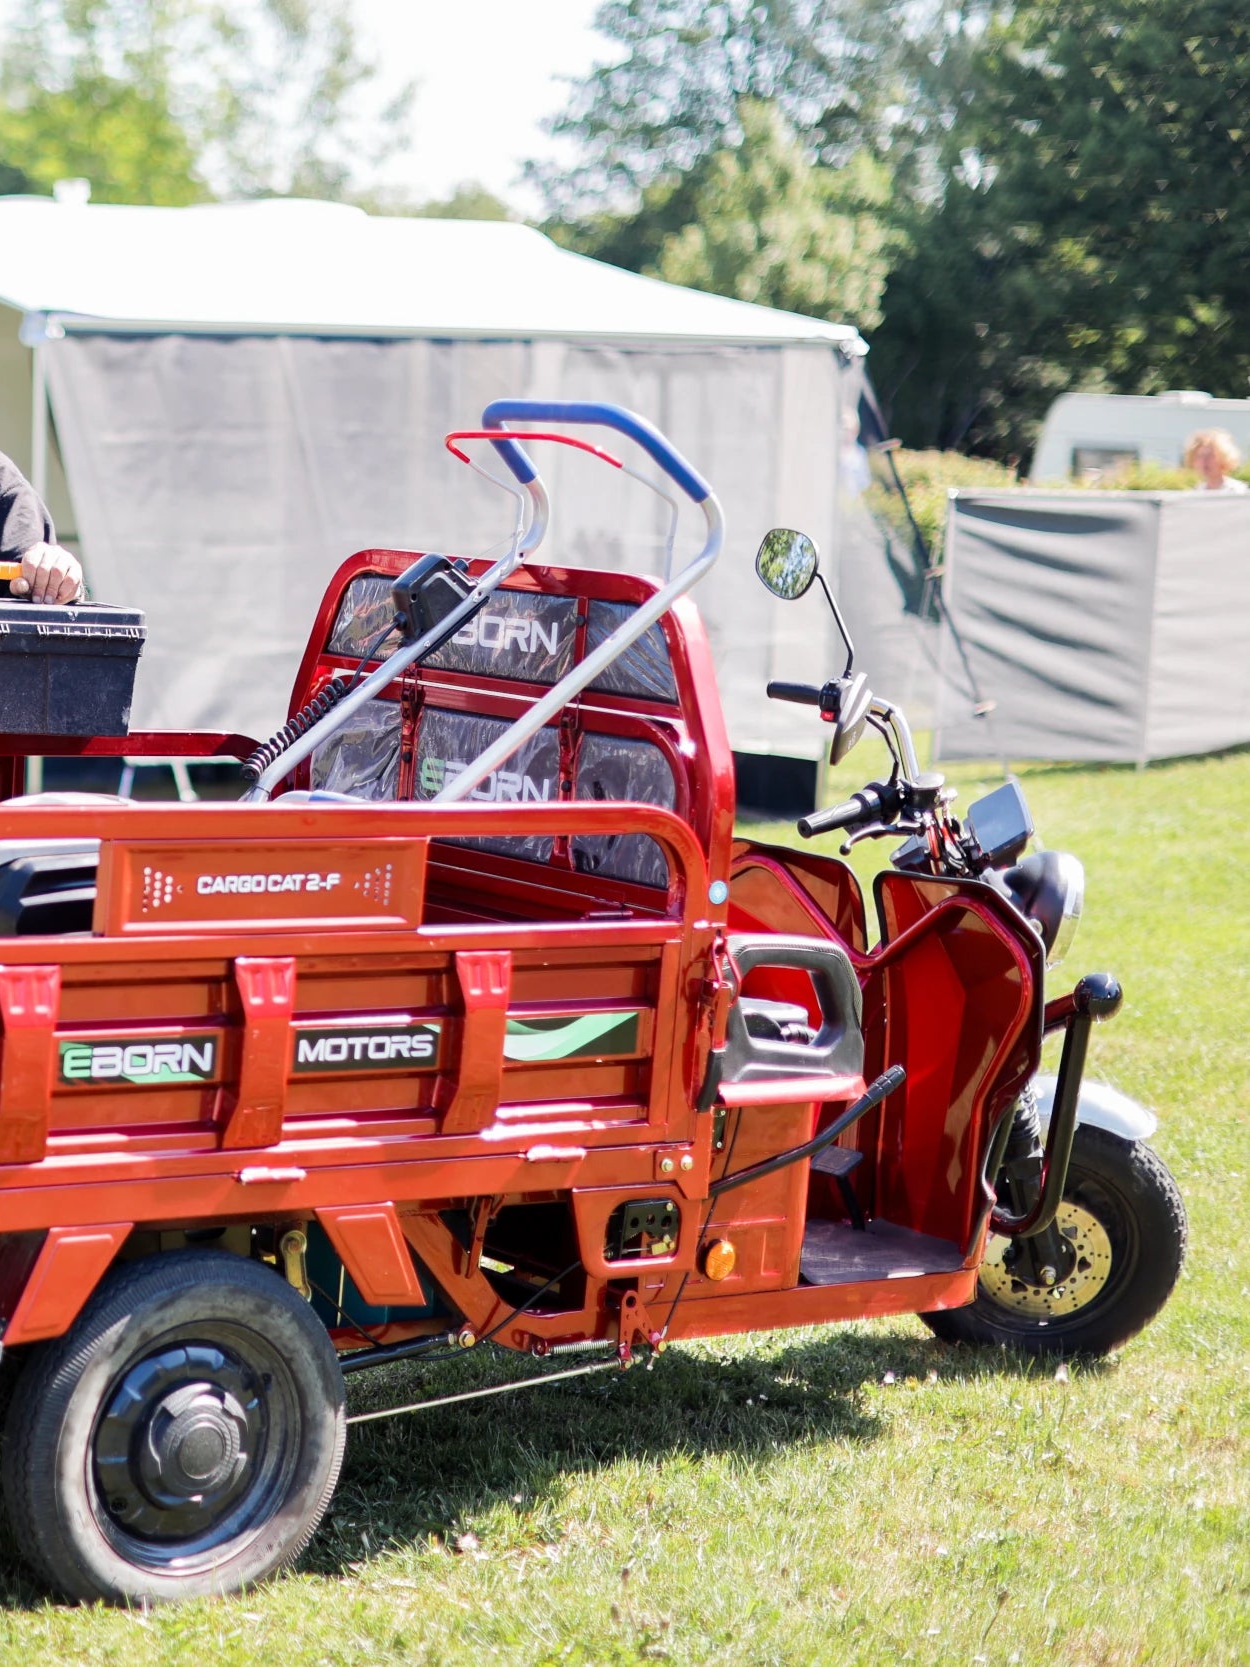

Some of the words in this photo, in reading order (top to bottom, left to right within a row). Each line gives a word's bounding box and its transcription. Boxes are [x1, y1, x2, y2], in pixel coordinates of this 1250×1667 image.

[451, 614, 558, 655] BORN
[197, 875, 266, 894] CARGO
[267, 874, 305, 892] CAT
[305, 873, 341, 891] 2-F
[63, 1042, 213, 1078] EBORN
[298, 1034, 434, 1062] MOTORS
